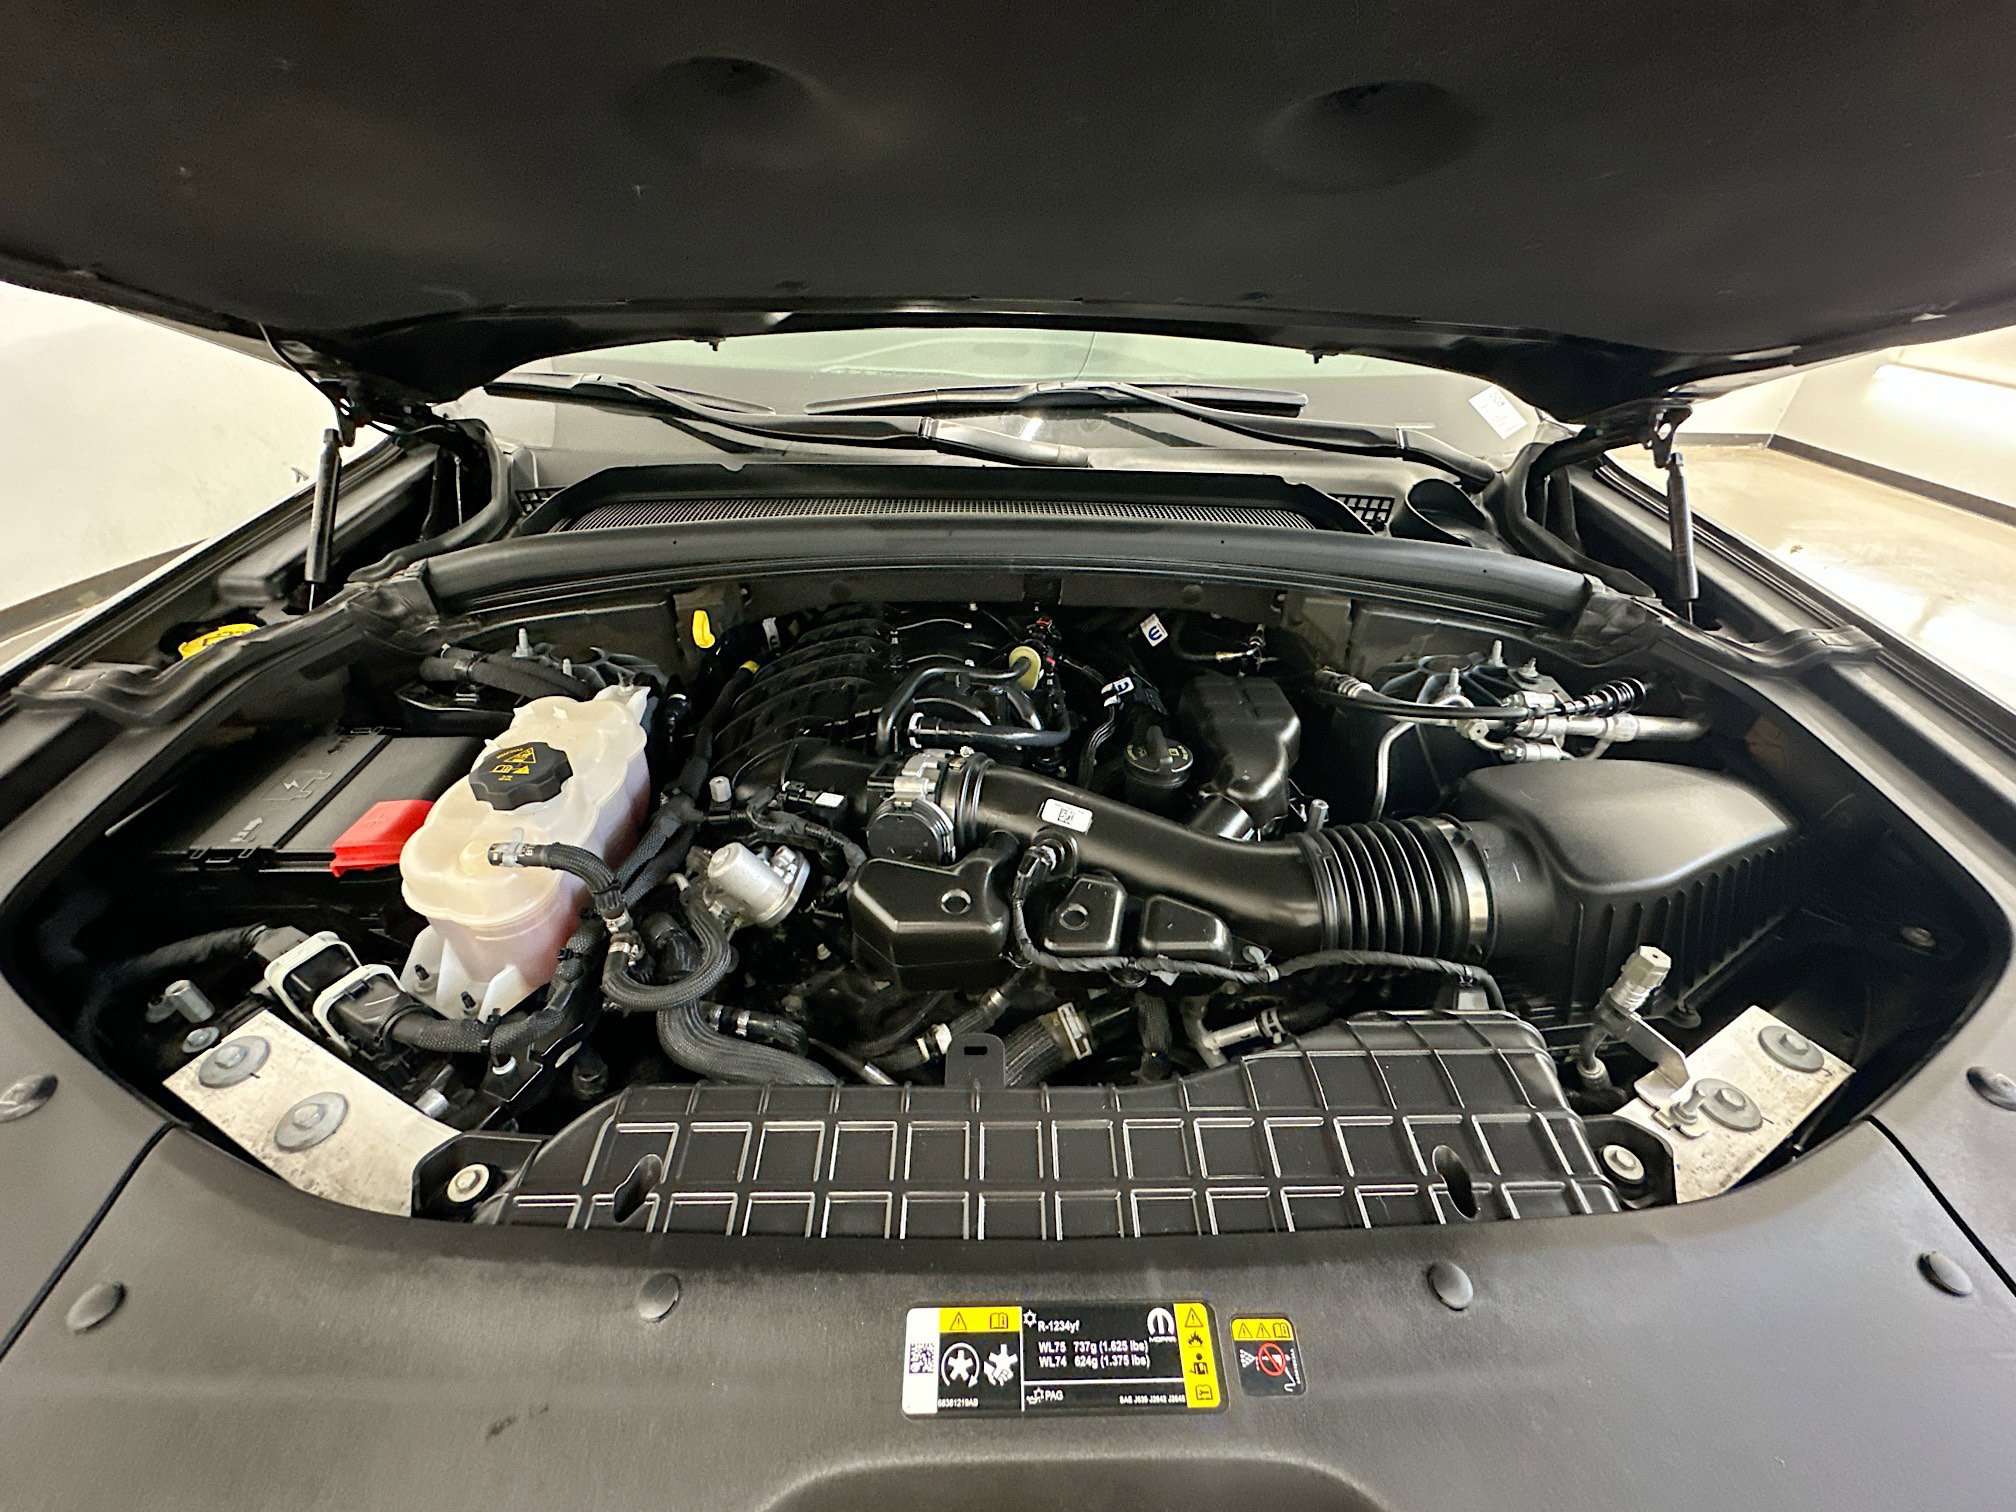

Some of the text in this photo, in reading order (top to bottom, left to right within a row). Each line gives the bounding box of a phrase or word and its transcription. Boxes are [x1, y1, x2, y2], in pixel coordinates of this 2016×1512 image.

[1038, 1320, 1080, 1334] R-1234yf
[1038, 1340, 1149, 1354] WL75 737g (1.625 lbs)
[1039, 1354, 1150, 1369] WL74 624g (1.375 lbs)
[1045, 1389, 1064, 1401] PAG
